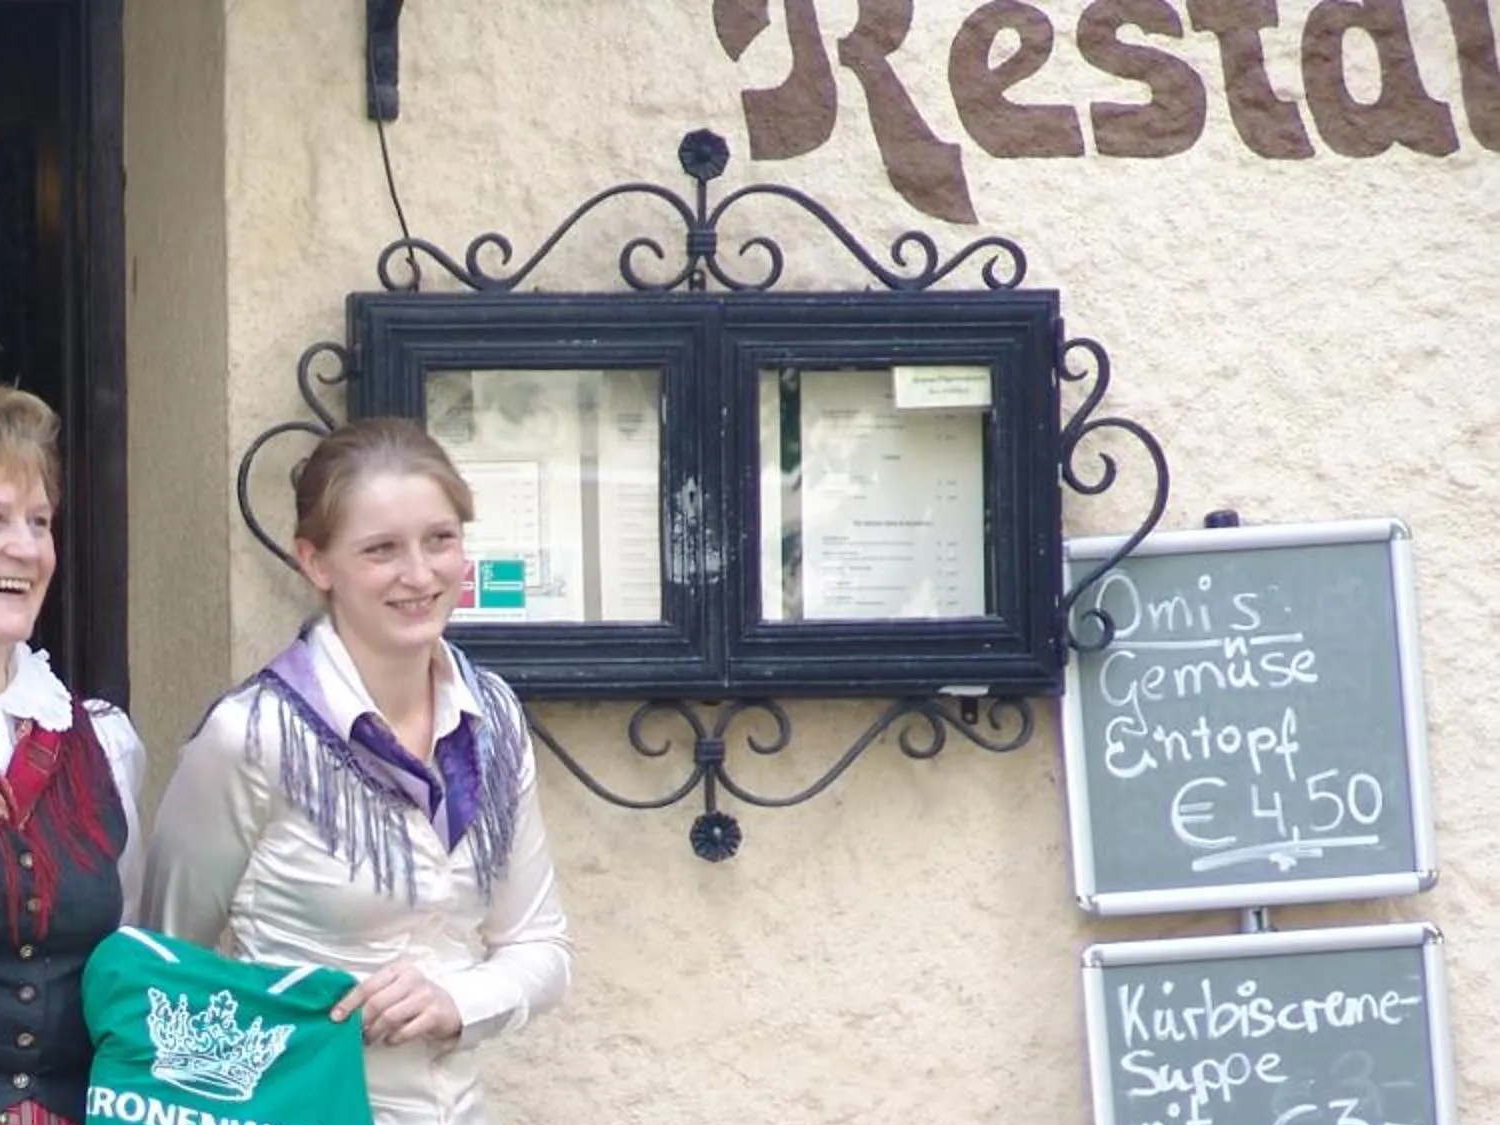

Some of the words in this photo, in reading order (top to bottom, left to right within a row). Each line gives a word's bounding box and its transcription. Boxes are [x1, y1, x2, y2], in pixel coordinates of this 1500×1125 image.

[1096, 573, 1261, 638] Omis
[1101, 636, 1319, 735] Gemüse
[1121, 1050, 1288, 1103] Suppe
